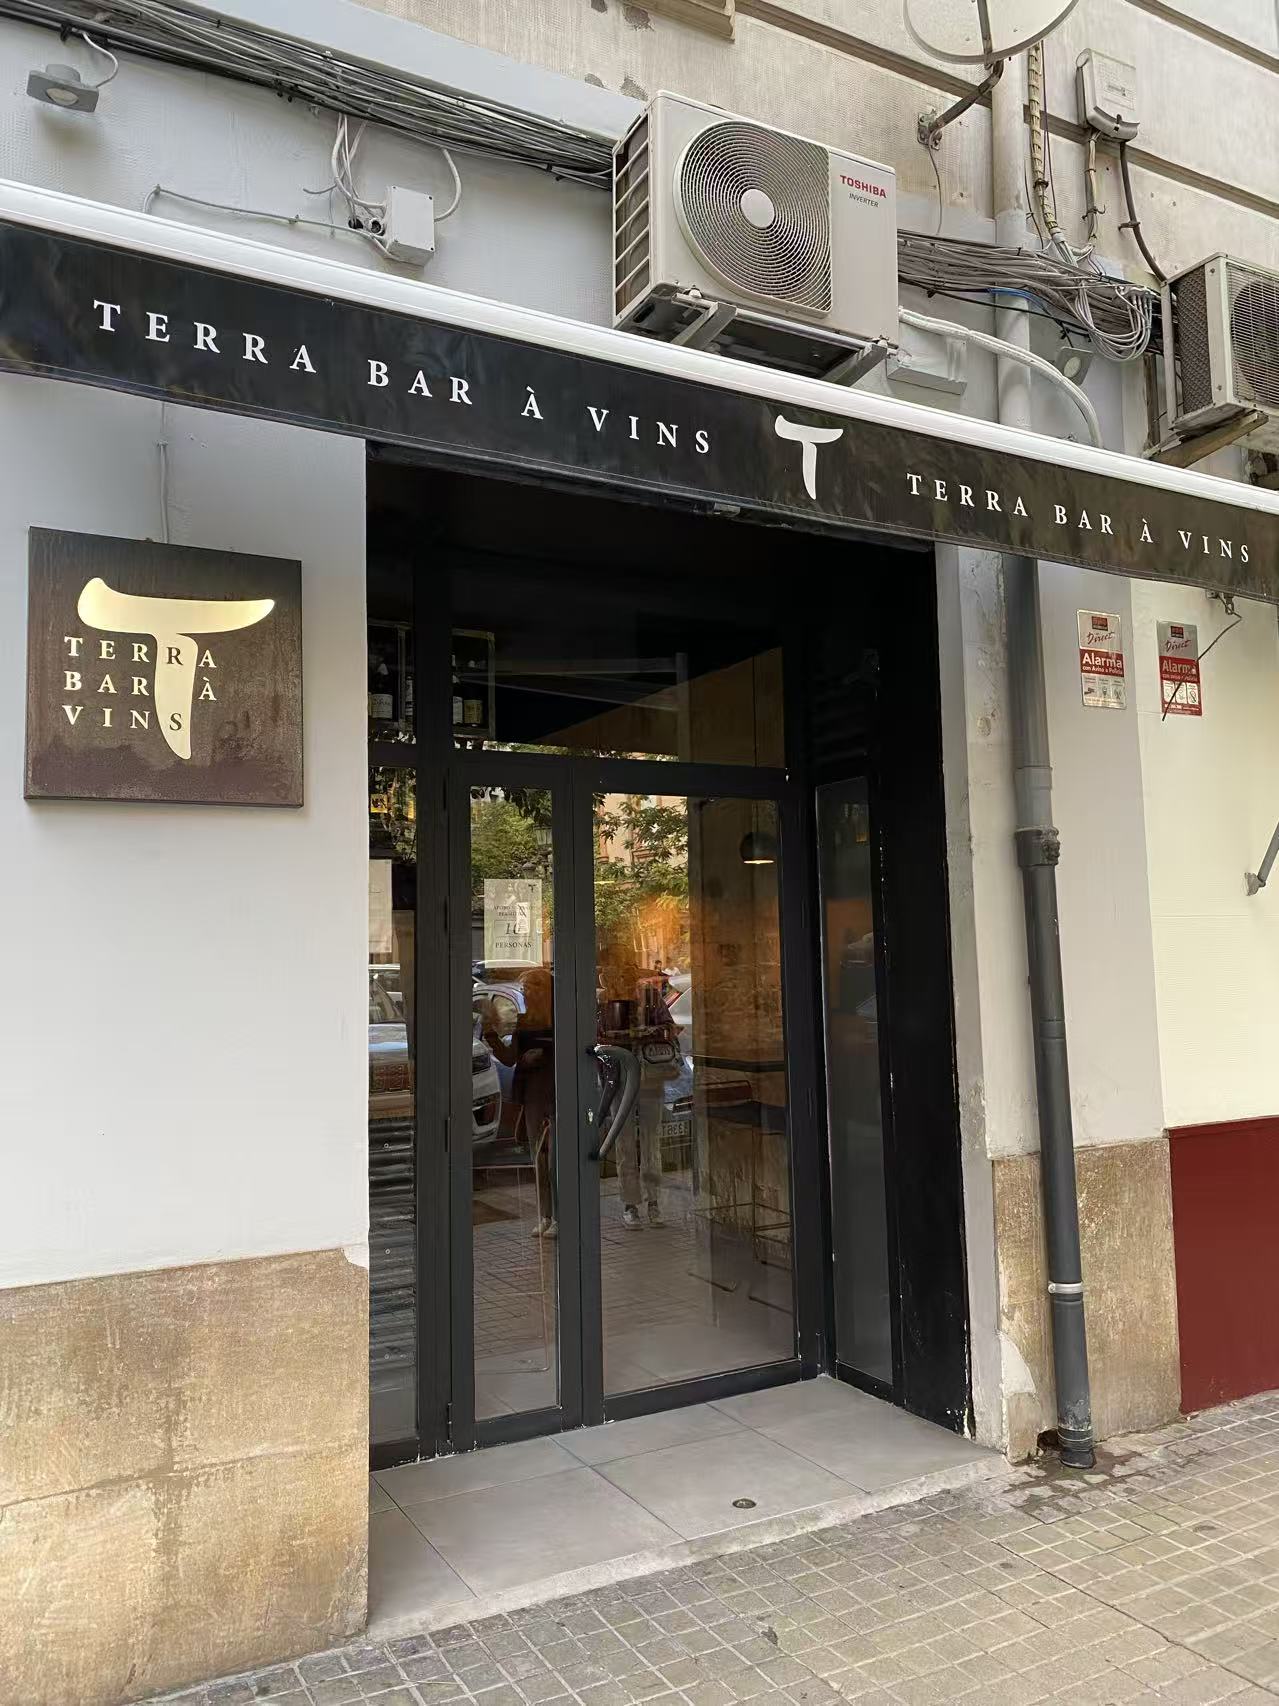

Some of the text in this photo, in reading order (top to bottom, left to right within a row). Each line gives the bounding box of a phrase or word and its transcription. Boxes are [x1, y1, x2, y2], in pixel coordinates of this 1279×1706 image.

[840, 174, 887, 198] TOSHIBA
[849, 193, 879, 207] INVERTER
[94, 299, 709, 454] TERRA BAR À VINS
[907, 472, 1250, 563] TERRA BAR À VINS
[63, 635, 218, 669] TERRA
[1082, 652, 1123, 669] Alarma
[63, 670, 218, 702] BAR À
[61, 703, 183, 732] VINS
[495, 941, 532, 949] PERSONAS
